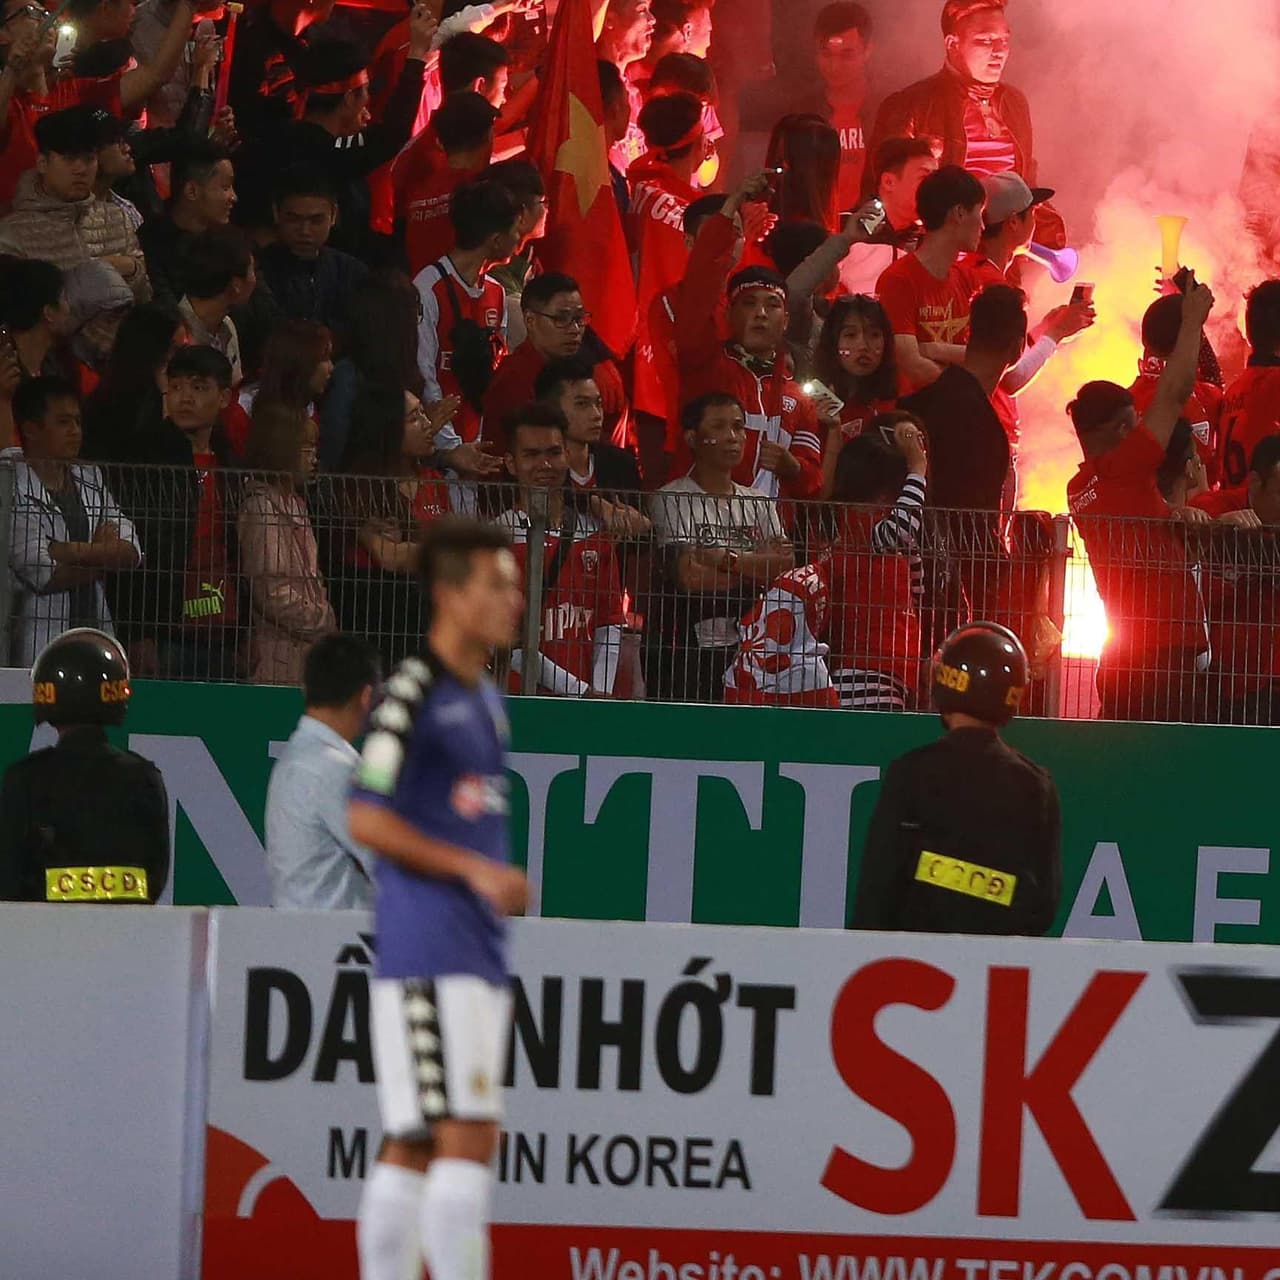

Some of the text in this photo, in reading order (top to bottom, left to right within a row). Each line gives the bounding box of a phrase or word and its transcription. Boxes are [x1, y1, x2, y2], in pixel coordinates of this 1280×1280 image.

[243, 933, 797, 1097] DẦ NHỚT
[819, 957, 1149, 1223] SK
[499, 1131, 753, 1191] IN KOREA
